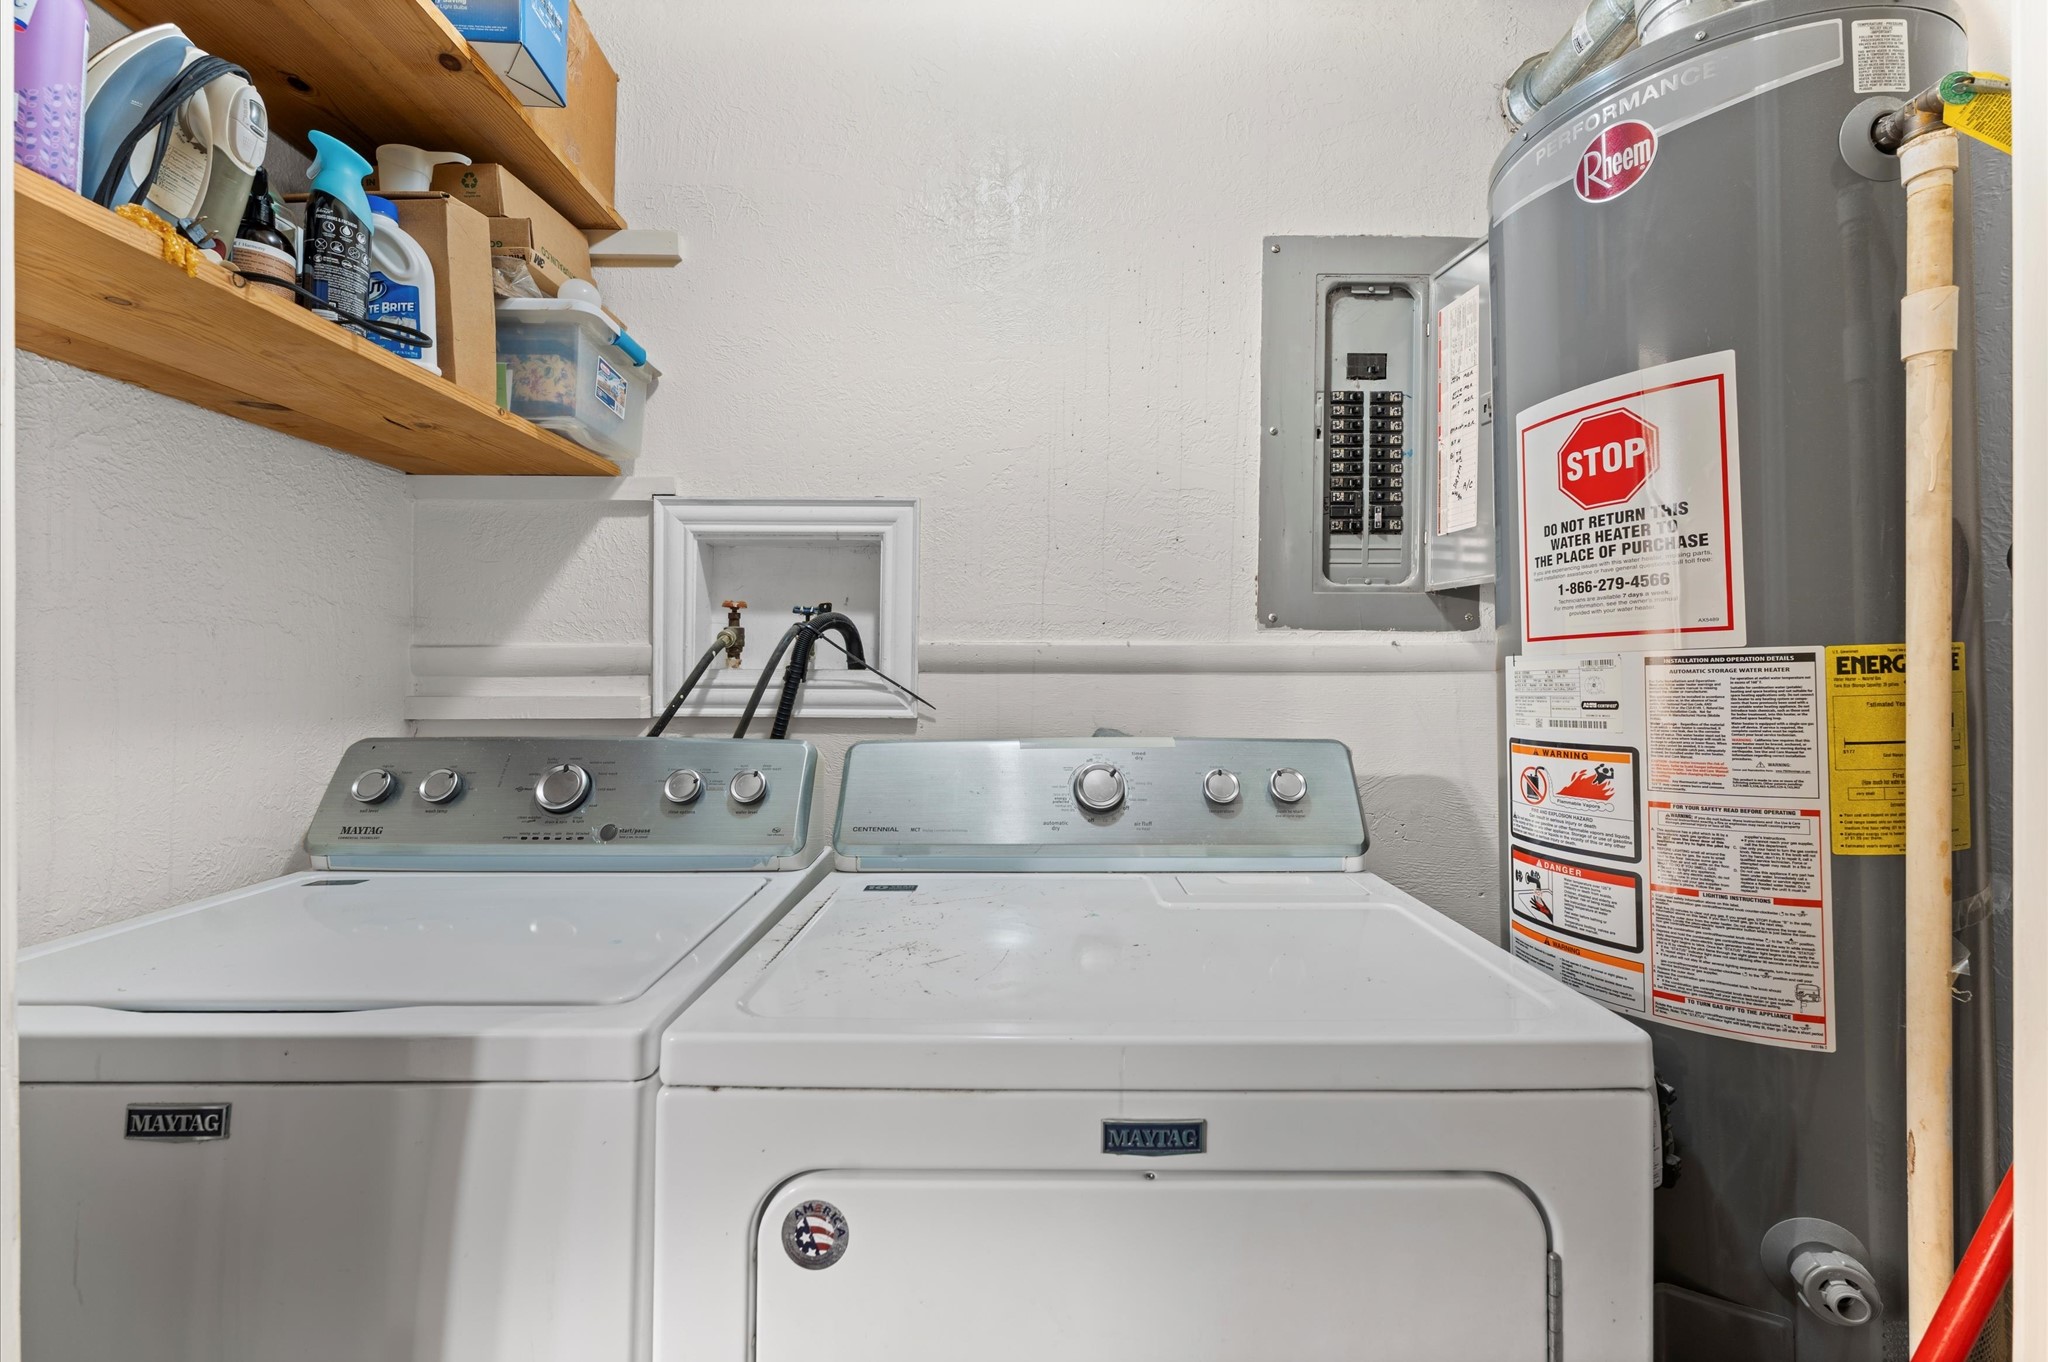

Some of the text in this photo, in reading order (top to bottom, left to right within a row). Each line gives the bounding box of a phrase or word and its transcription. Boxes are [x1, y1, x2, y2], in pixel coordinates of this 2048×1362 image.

[1535, 60, 1718, 166] PERFORMANCE
[1583, 133, 1651, 197] Rheem
[533, 252, 545, 269] 3M
[382, 302, 415, 313] BRITE
[1566, 437, 1646, 482] STOP
[1544, 501, 1689, 537] DO NOT RETURN THIS
[1550, 532, 1590, 550] WATER
[1595, 523, 1651, 543] HEATER
[1534, 533, 1709, 568] THE PLACE OF PURCHASE
[1558, 572, 1670, 596] 1-866-279-4566
[1664, 656, 1708, 664] INSTALLATION
[1836, 654, 1906, 675] ENERG
[1542, 749, 1589, 760] WARNING
[1556, 798, 1601, 810] Flammable Vapors
[1548, 810, 1573, 820] EXPLOSION
[1573, 814, 1594, 822] HAZARD
[340, 826, 384, 835] MAYTAG
[1544, 861, 1582, 877] DANGER
[1702, 892, 1771, 904] LIGHTING INSTRUCTIONS
[1552, 941, 1581, 956] WARNING
[1712, 1002, 1724, 1010] GAS
[1758, 1010, 1792, 1020] APPLIANCE
[130, 1114, 220, 1132] MAYTAG
[1108, 1128, 1198, 1148] MAYTAG
[794, 1203, 846, 1238] AMERICA
